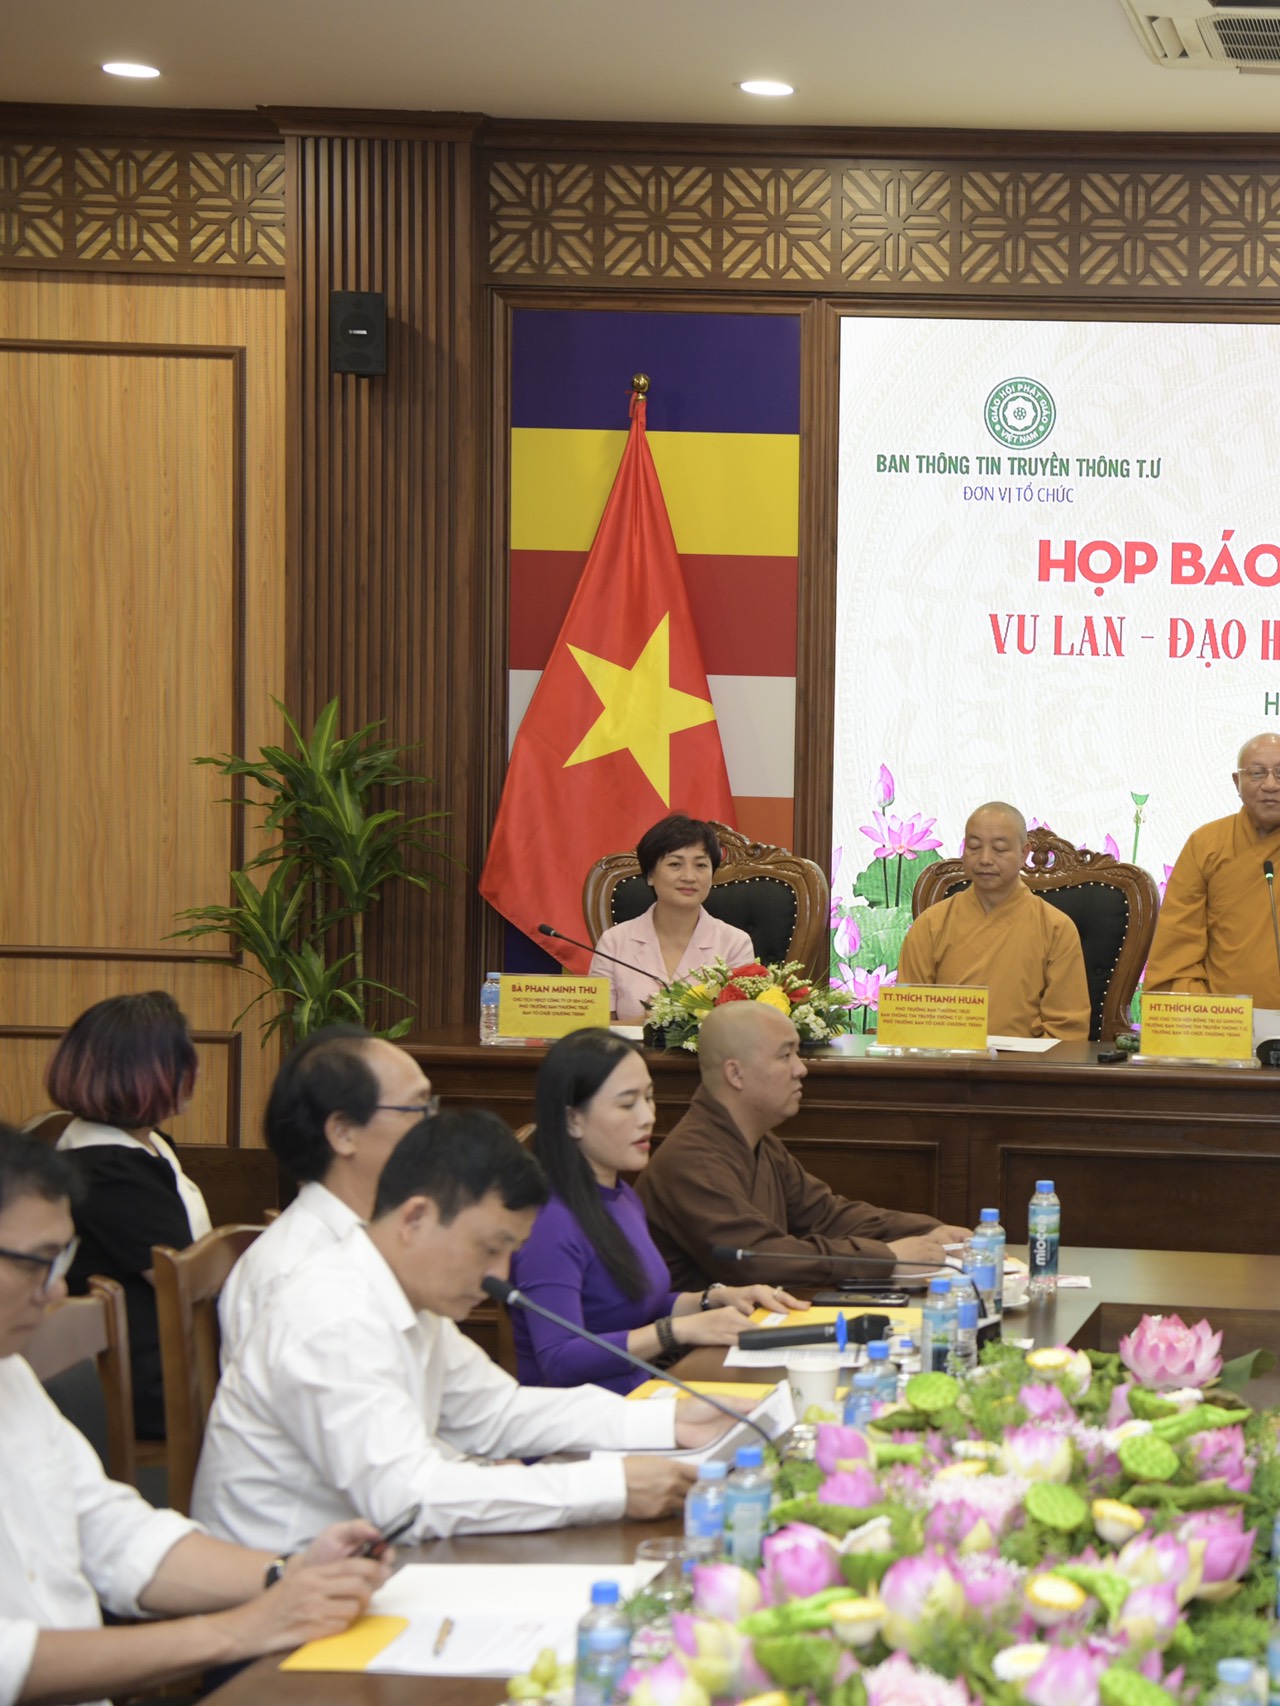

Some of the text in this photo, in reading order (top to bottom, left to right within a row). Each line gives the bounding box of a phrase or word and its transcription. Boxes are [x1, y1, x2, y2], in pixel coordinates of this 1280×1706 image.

[989, 398, 1000, 422] GIÁO
[999, 383, 1016, 399] HỘI
[1040, 399, 1051, 423] GIÁO
[1001, 429, 1039, 443] VIỆT NAM
[876, 451, 1161, 479] BAN THÔNG TIN TRUYỀN THÔNG T.Ư
[963, 481, 1074, 503] ĐƠN VỊ TỔ CHỨC
[1037, 539, 1158, 598] HỌP
[989, 613, 1039, 655] VU
[1053, 615, 1126, 657] LAN
[1168, 617, 1246, 669] ĐẠO
[511, 983, 522, 992] BÀ
[525, 985, 550, 993] PHAN
[578, 986, 597, 994] THU
[883, 992, 922, 1002] TT.THÍCH
[924, 995, 956, 1004] THANH
[1150, 1003, 1244, 1015] HT.THÍCH GIA QUANG
